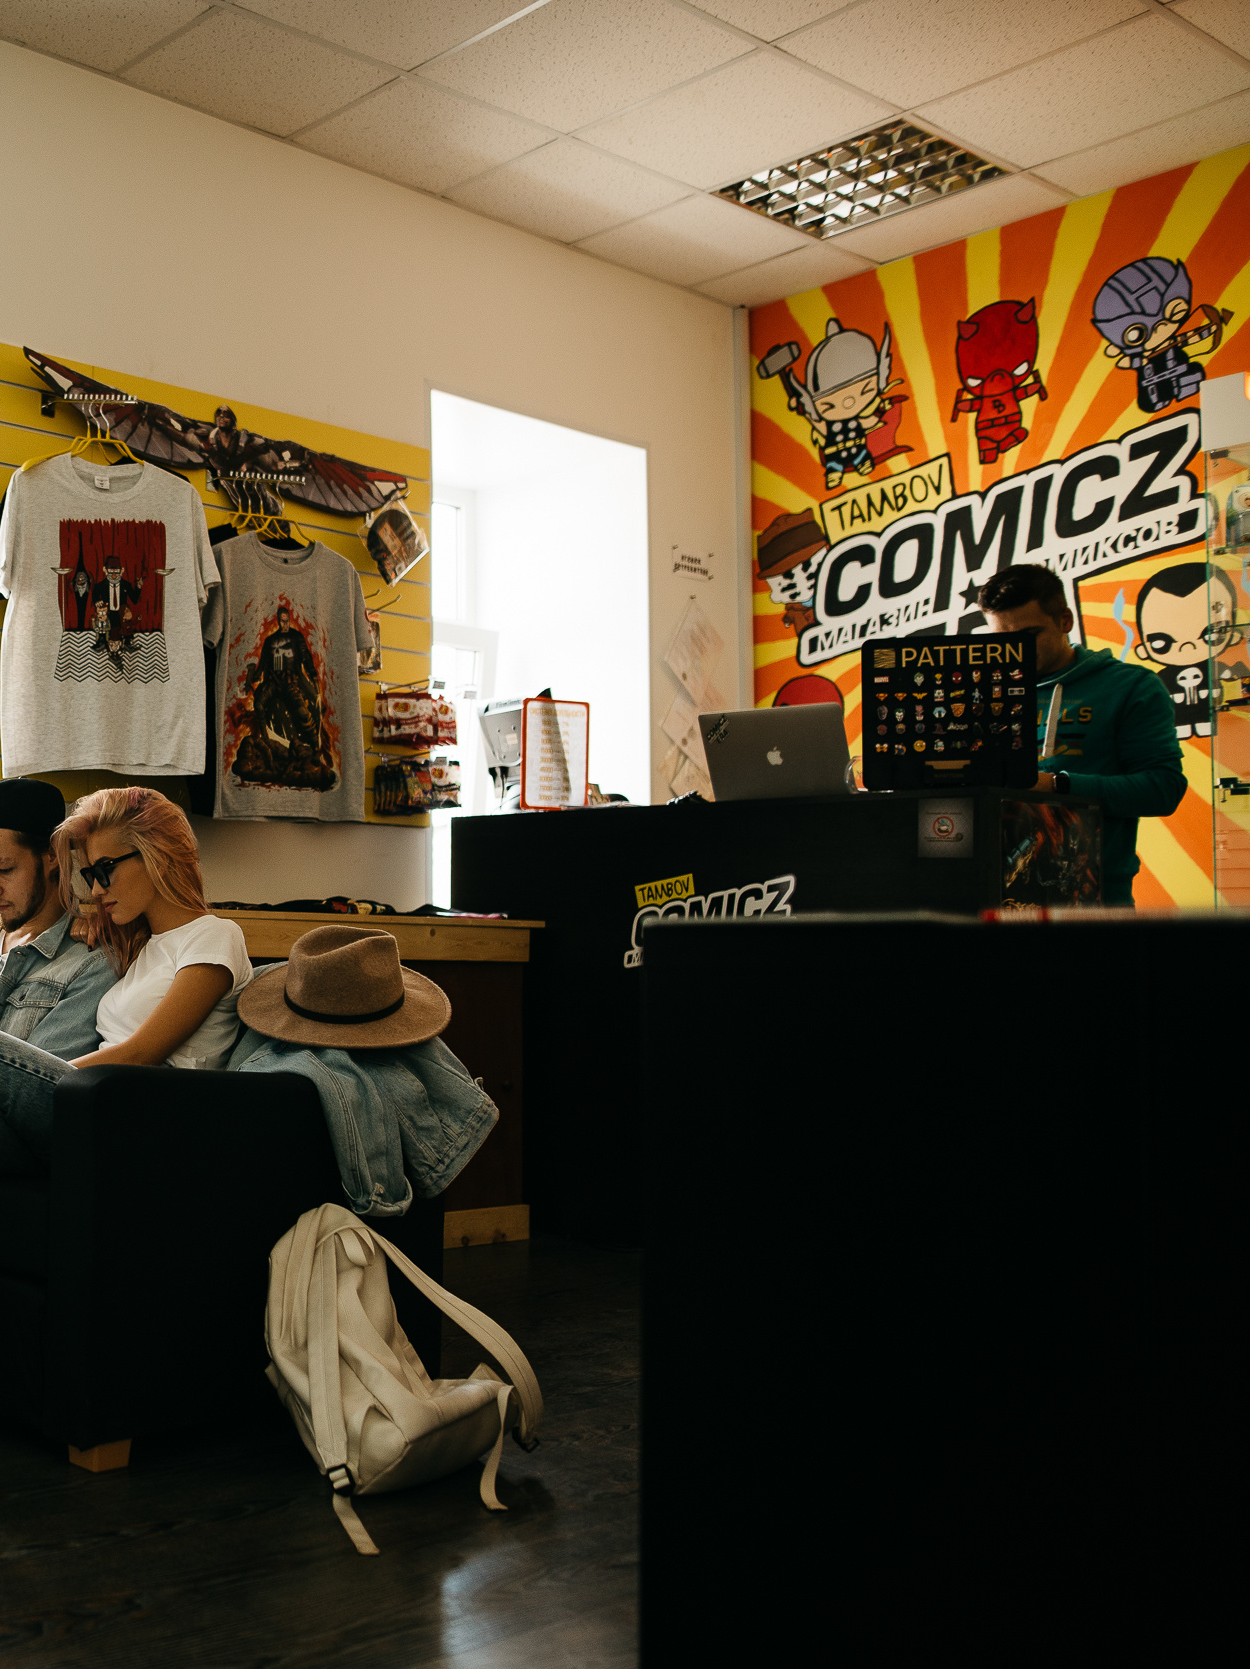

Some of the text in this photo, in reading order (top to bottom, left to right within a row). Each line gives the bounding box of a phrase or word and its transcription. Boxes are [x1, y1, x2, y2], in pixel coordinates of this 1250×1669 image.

[824, 421, 1191, 617] COMICZ
[830, 470, 945, 532] TAMBOV
[816, 596, 934, 653] МАГАЗИН
[1047, 515, 1180, 573] МИКСОВ
[901, 642, 1023, 668] PATTERN
[638, 876, 691, 904] TAMBOV
